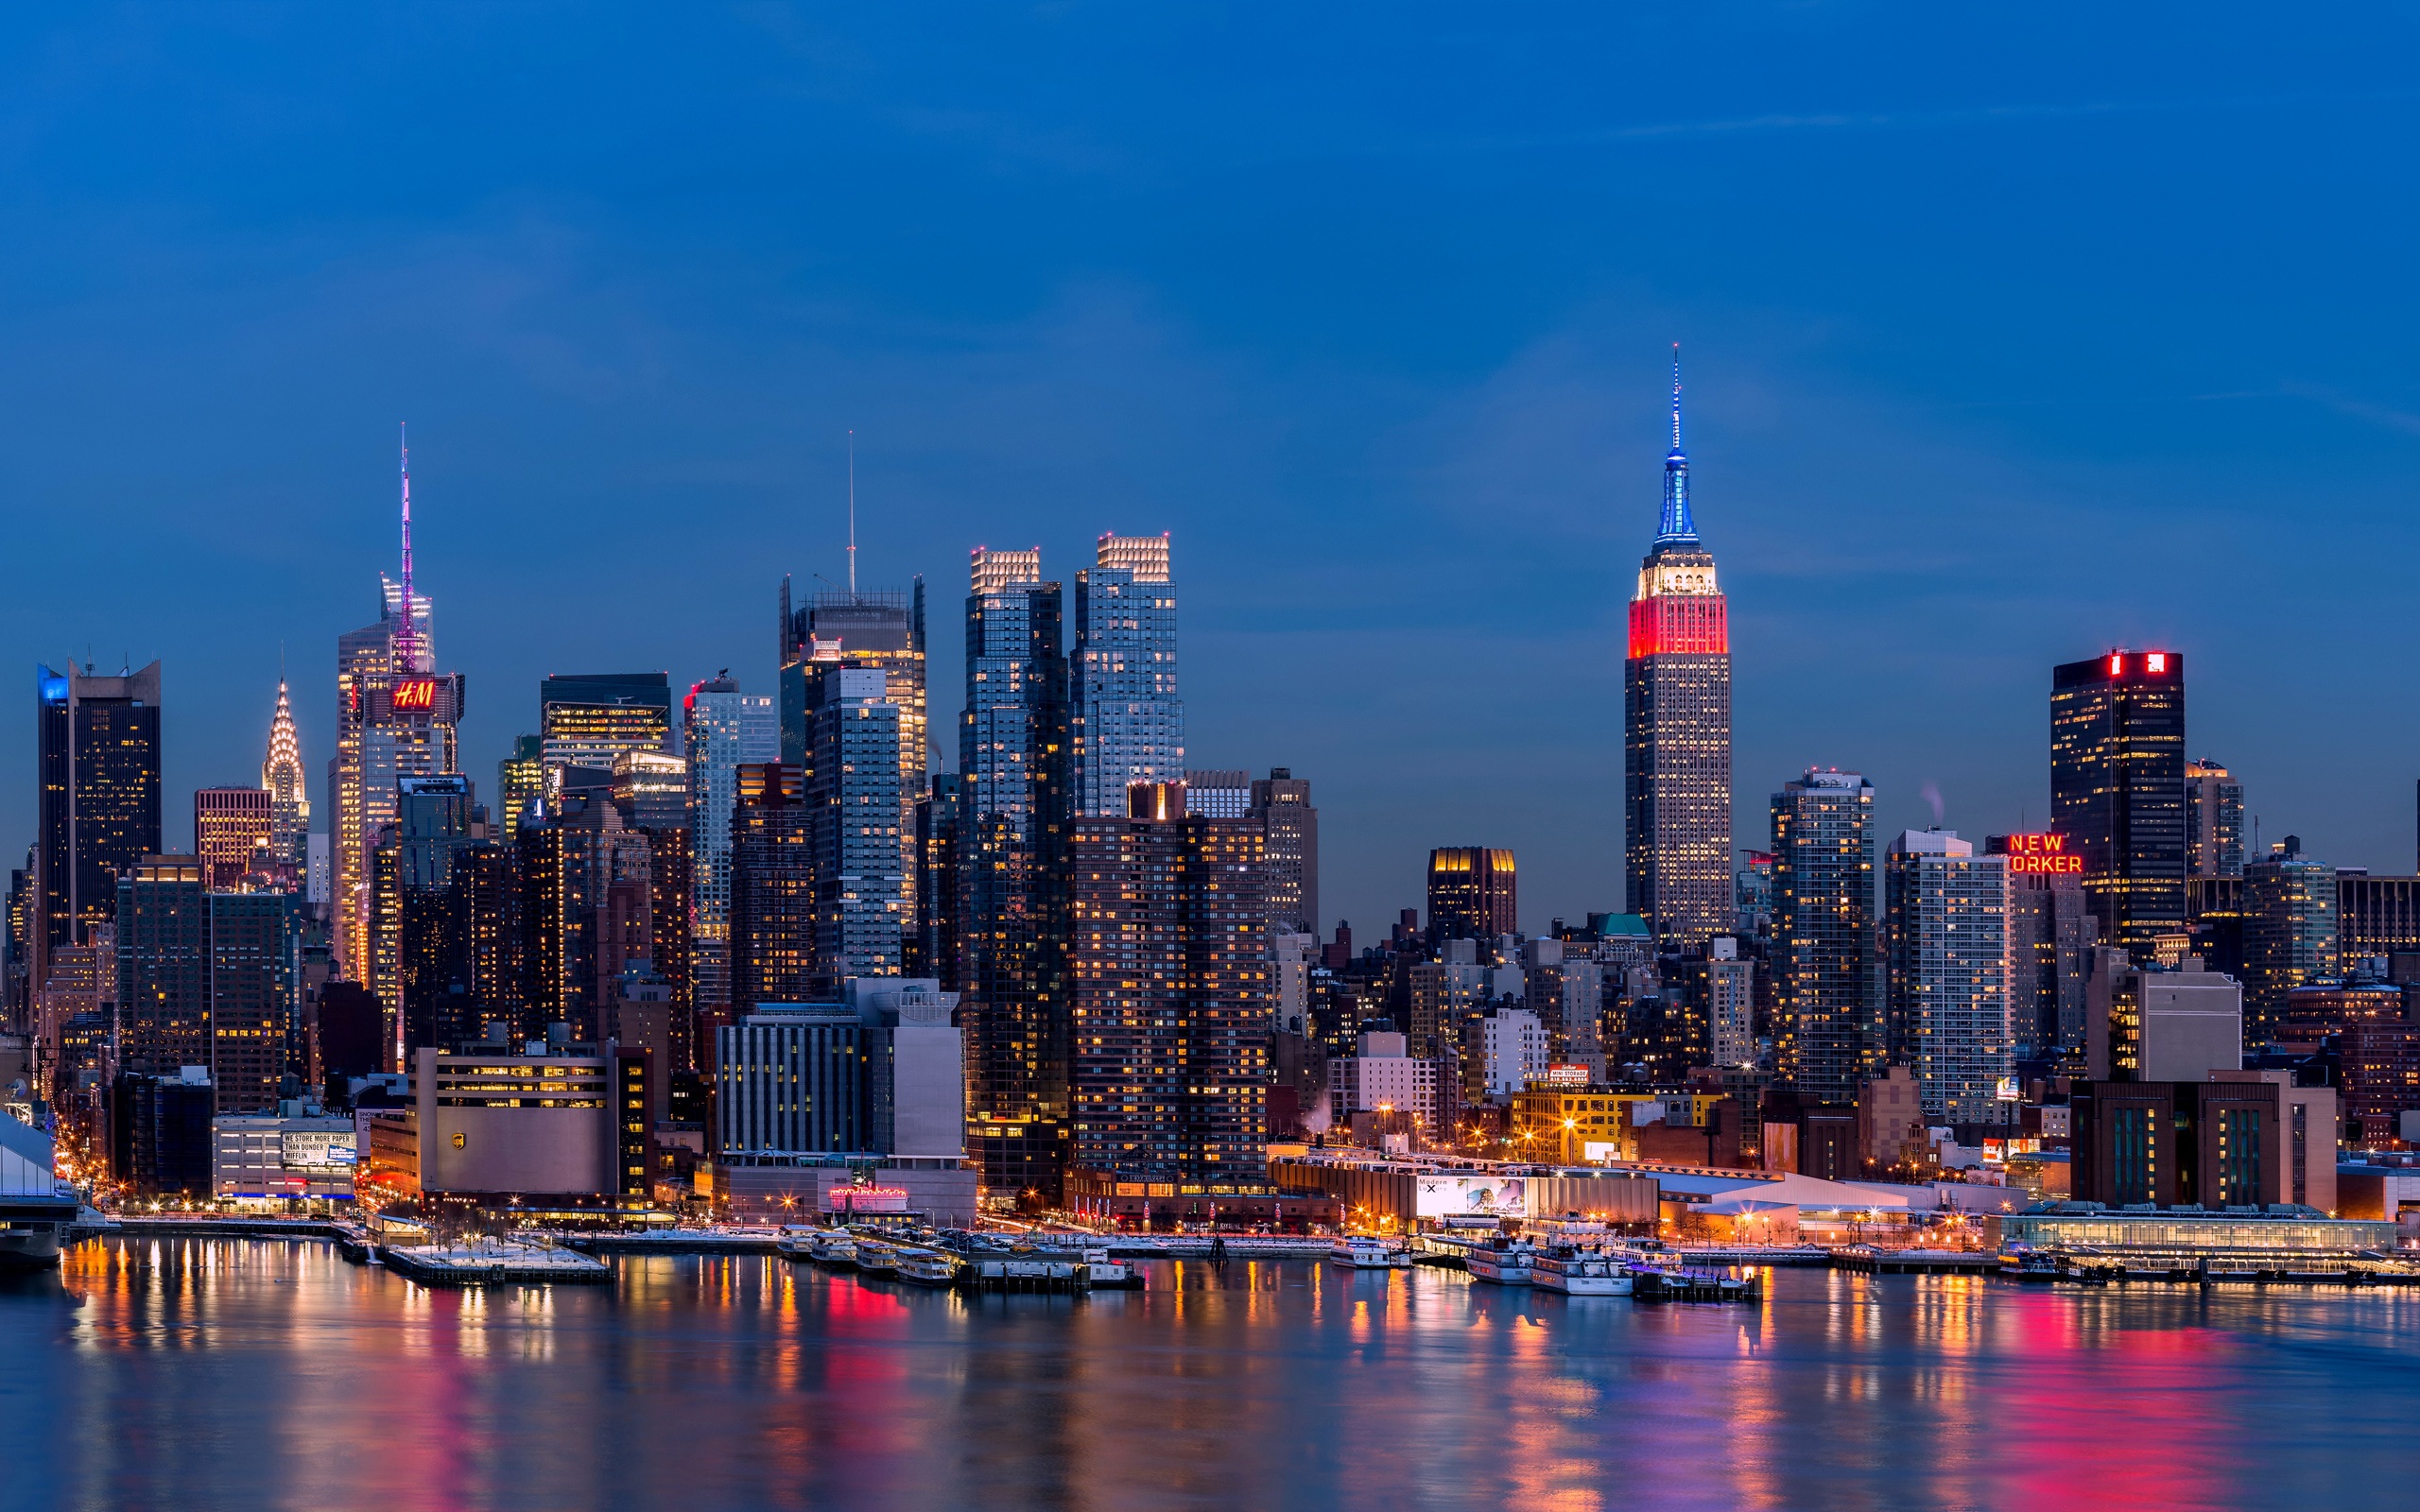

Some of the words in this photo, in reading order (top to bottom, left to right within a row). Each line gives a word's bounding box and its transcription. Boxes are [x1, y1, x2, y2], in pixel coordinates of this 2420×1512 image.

[394, 681, 434, 706] H&M
[2011, 835, 2062, 850] NEW
[2010, 856, 2082, 872] ORKER
